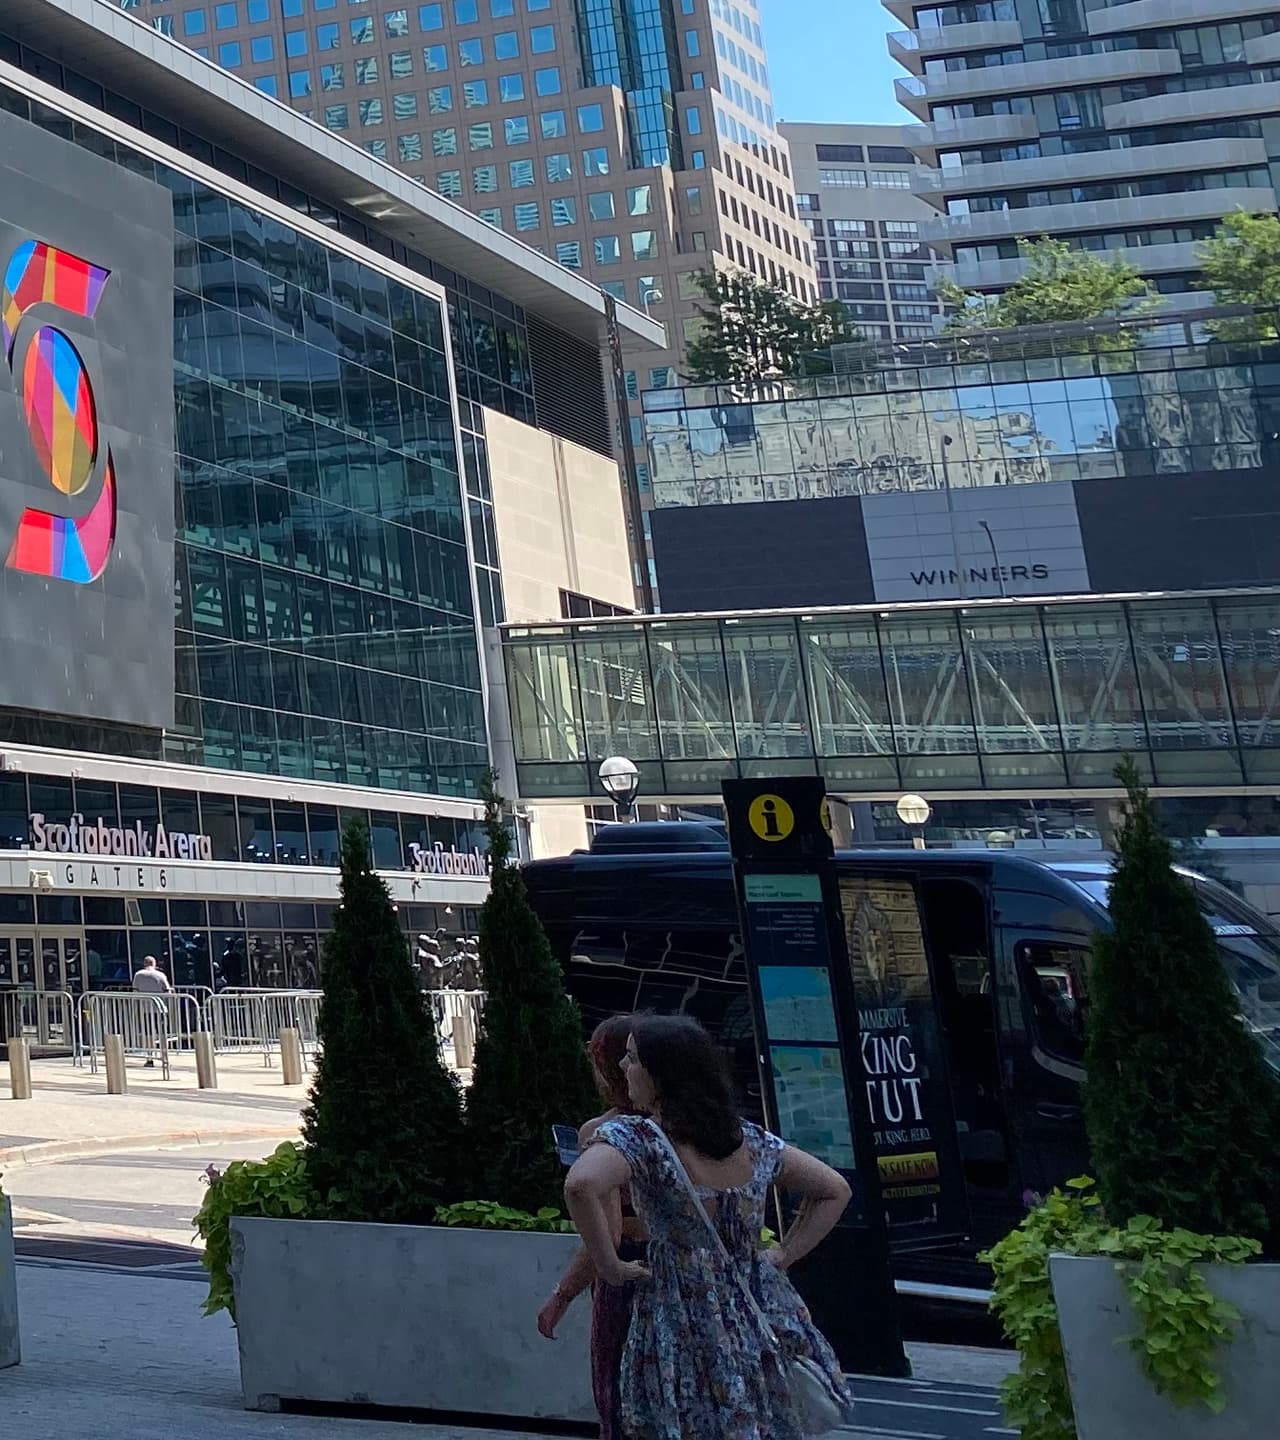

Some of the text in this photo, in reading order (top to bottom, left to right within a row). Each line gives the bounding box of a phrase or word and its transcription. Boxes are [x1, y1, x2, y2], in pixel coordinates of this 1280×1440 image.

[910, 564, 1049, 586] WINNERS
[29, 812, 213, 861] Scotiabank Arena
[66, 864, 168, 888] GATE 6
[858, 1007, 910, 1030] MMERSIVE
